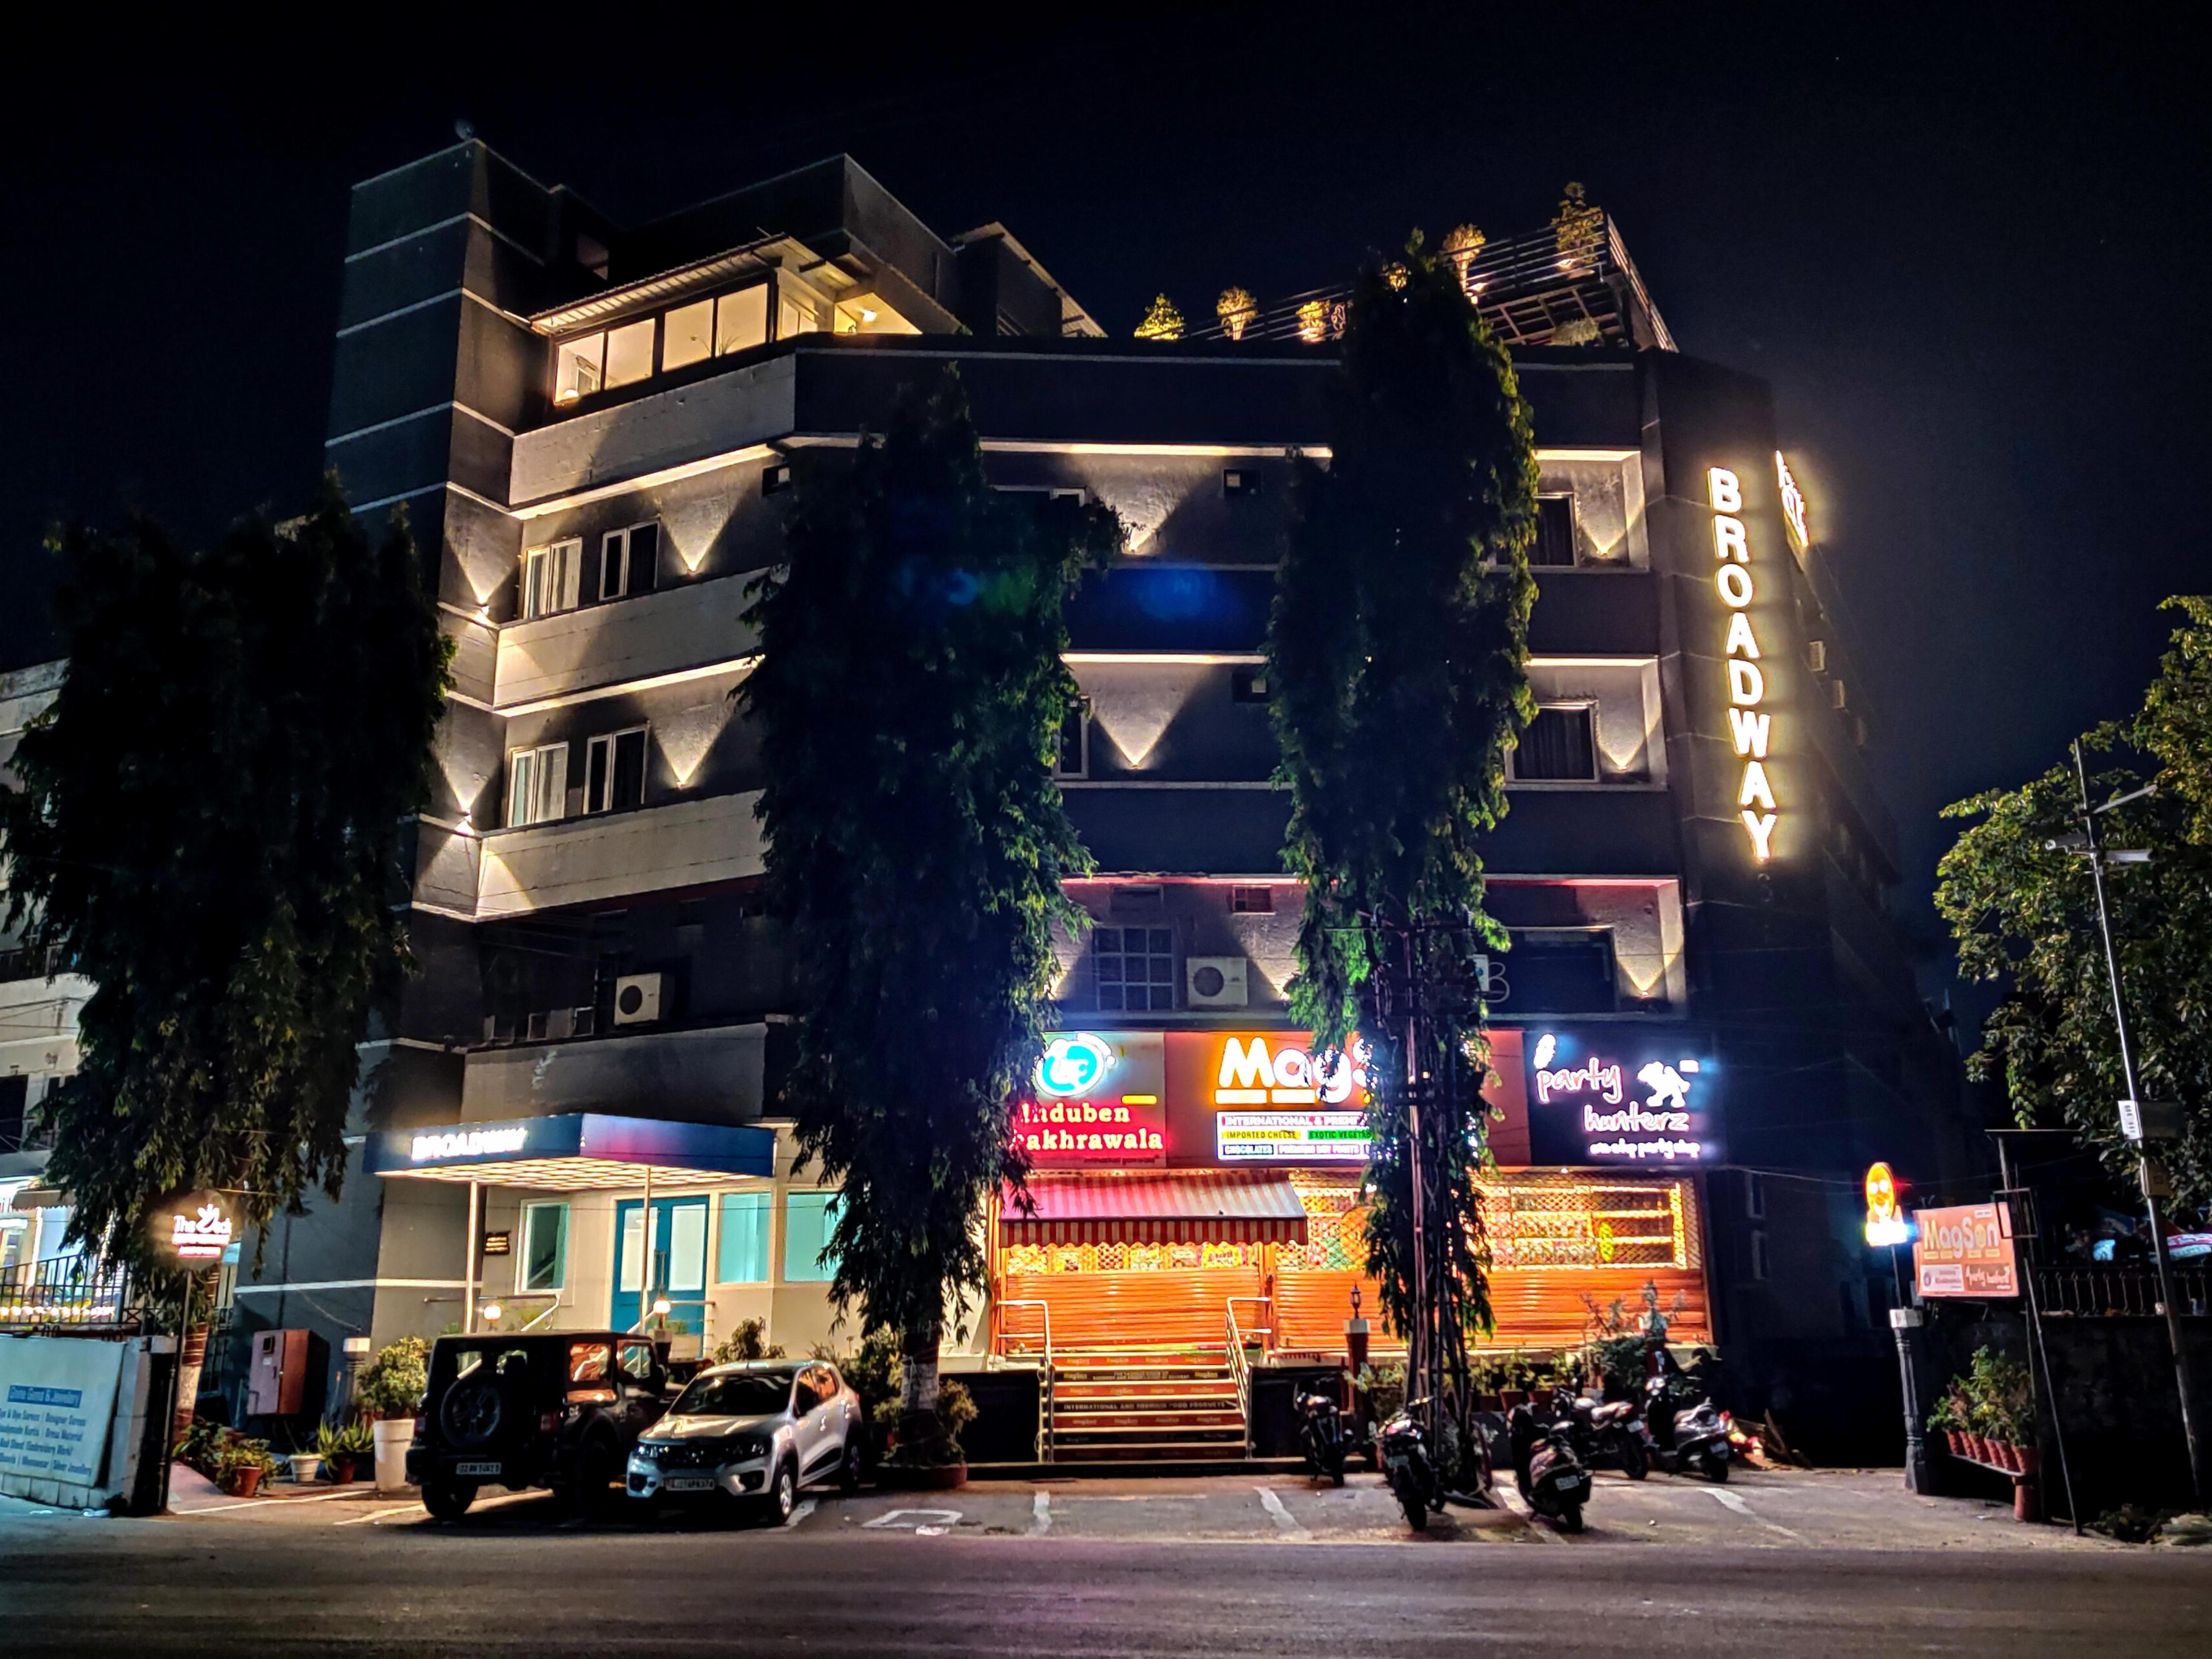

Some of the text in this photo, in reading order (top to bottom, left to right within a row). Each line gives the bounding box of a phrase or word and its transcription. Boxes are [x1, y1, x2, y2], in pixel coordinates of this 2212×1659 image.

[1708, 467, 1776, 862] BROADWAY
[1536, 1057, 1622, 1104] party
[1267, 1131, 1297, 1139] CHEESE
[1924, 1216, 1999, 1258] MagSon
